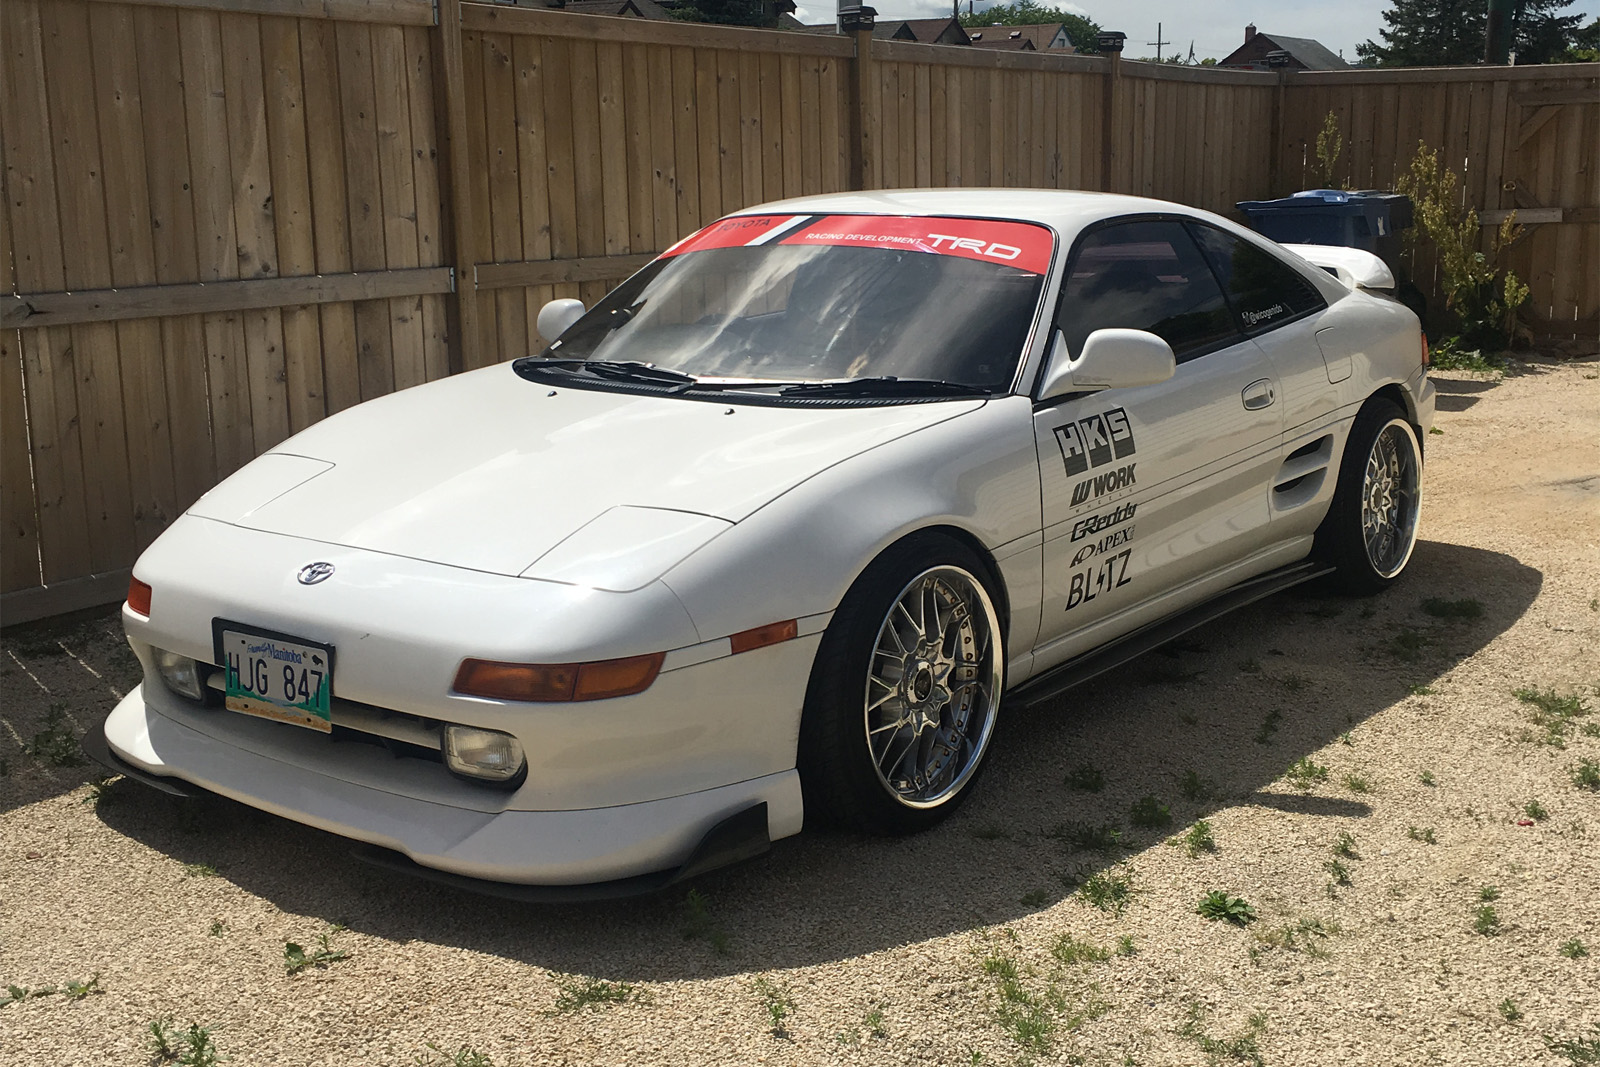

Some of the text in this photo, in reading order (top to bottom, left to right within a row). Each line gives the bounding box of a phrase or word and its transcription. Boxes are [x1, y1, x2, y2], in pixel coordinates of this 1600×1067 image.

[845, 233, 924, 245] DEVELOPMENT
[927, 233, 1022, 260] TRD
[1052, 407, 1136, 474] HKS
[1093, 463, 1137, 498] WORK
[268, 643, 302, 664] Manitoba
[228, 652, 323, 708] HJG 847
